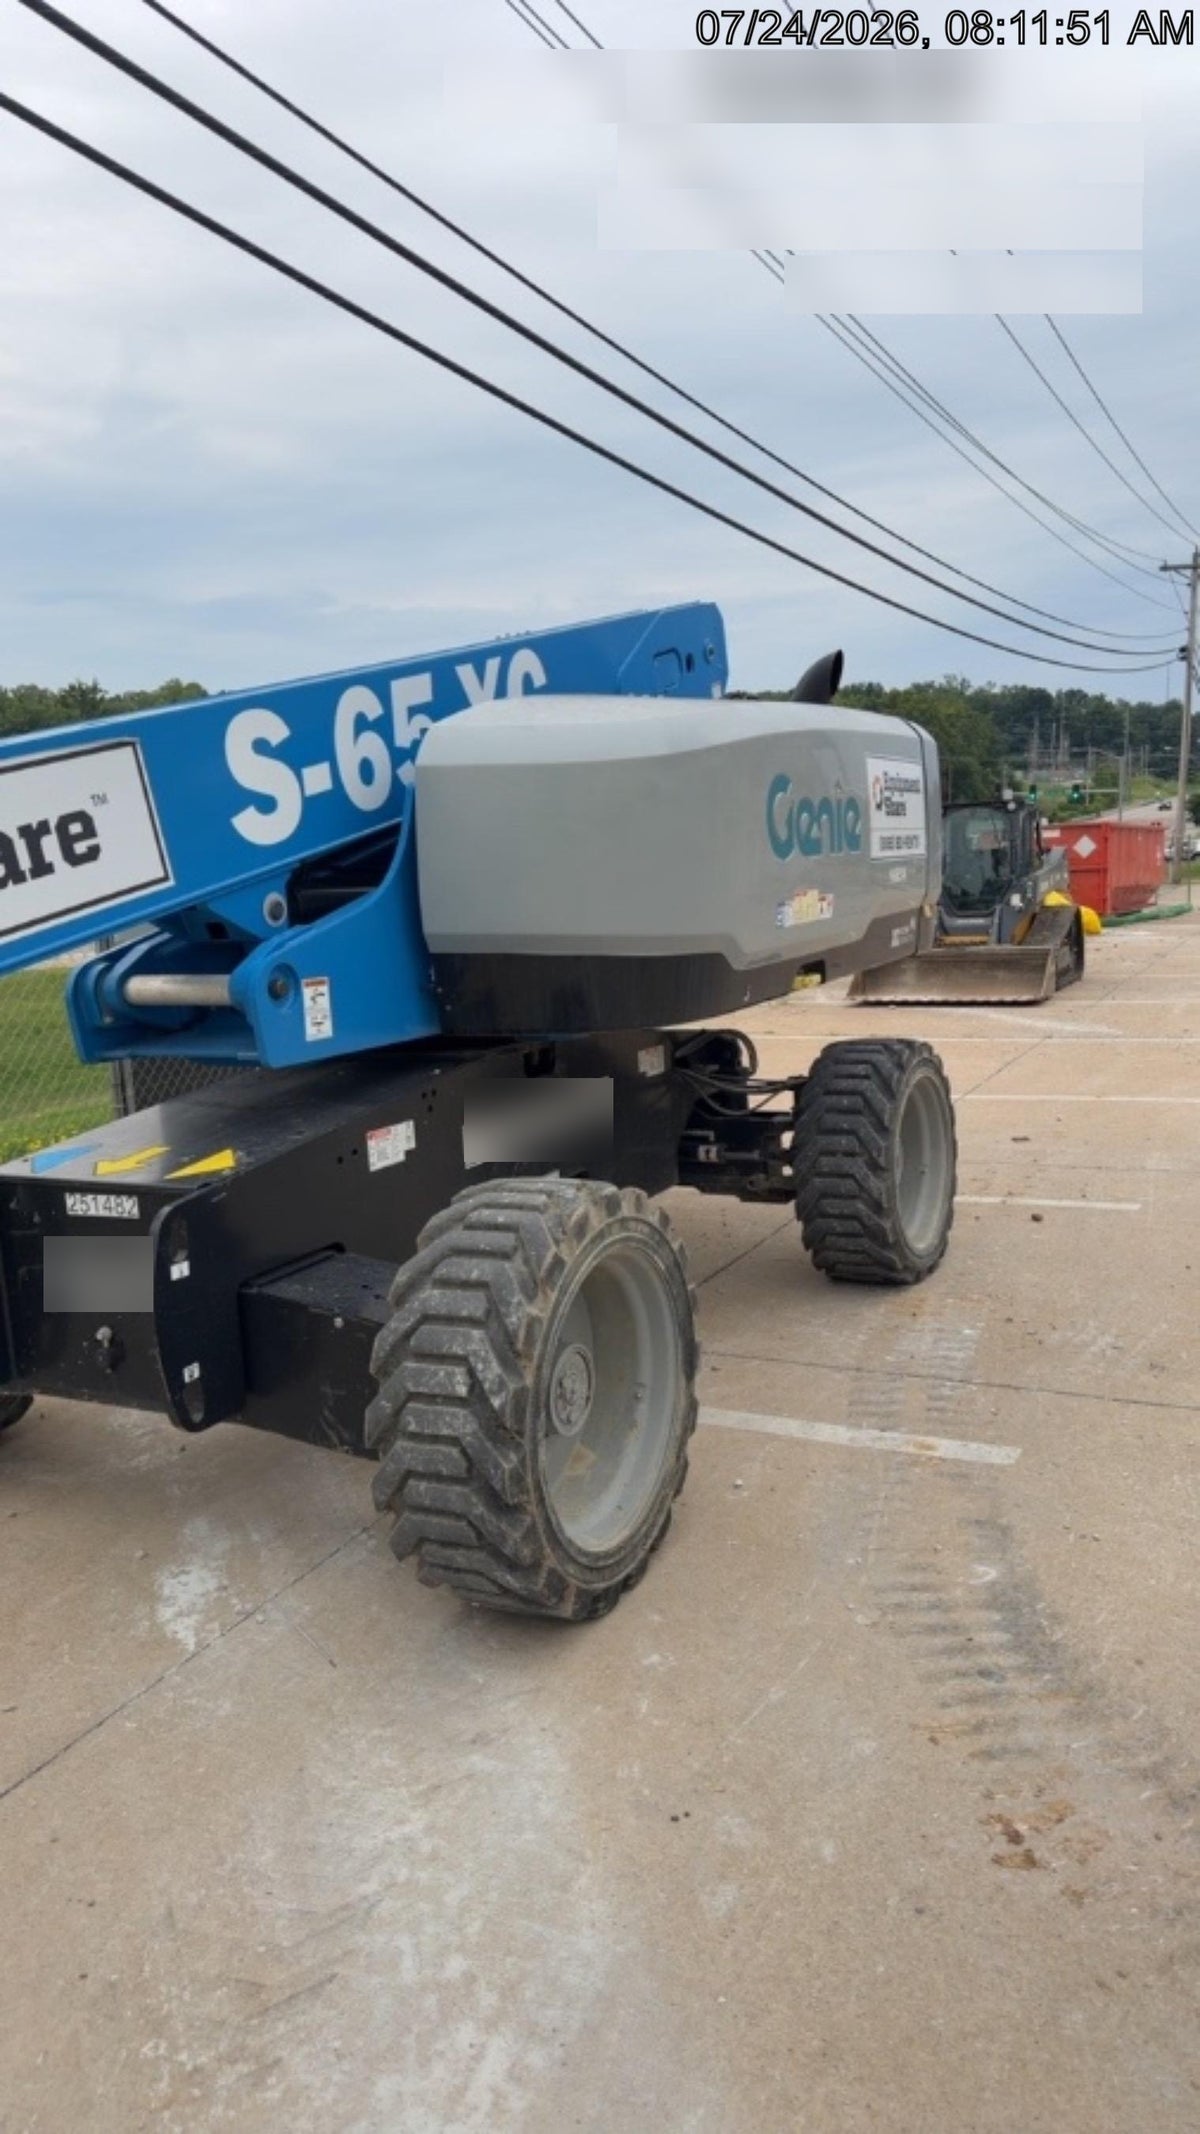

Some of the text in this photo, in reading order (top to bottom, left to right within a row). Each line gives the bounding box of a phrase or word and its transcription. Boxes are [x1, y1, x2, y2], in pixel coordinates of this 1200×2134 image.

[225, 672, 433, 846] S-65
[767, 773, 861, 861] Genie
[66, 1191, 139, 1217] 251482
